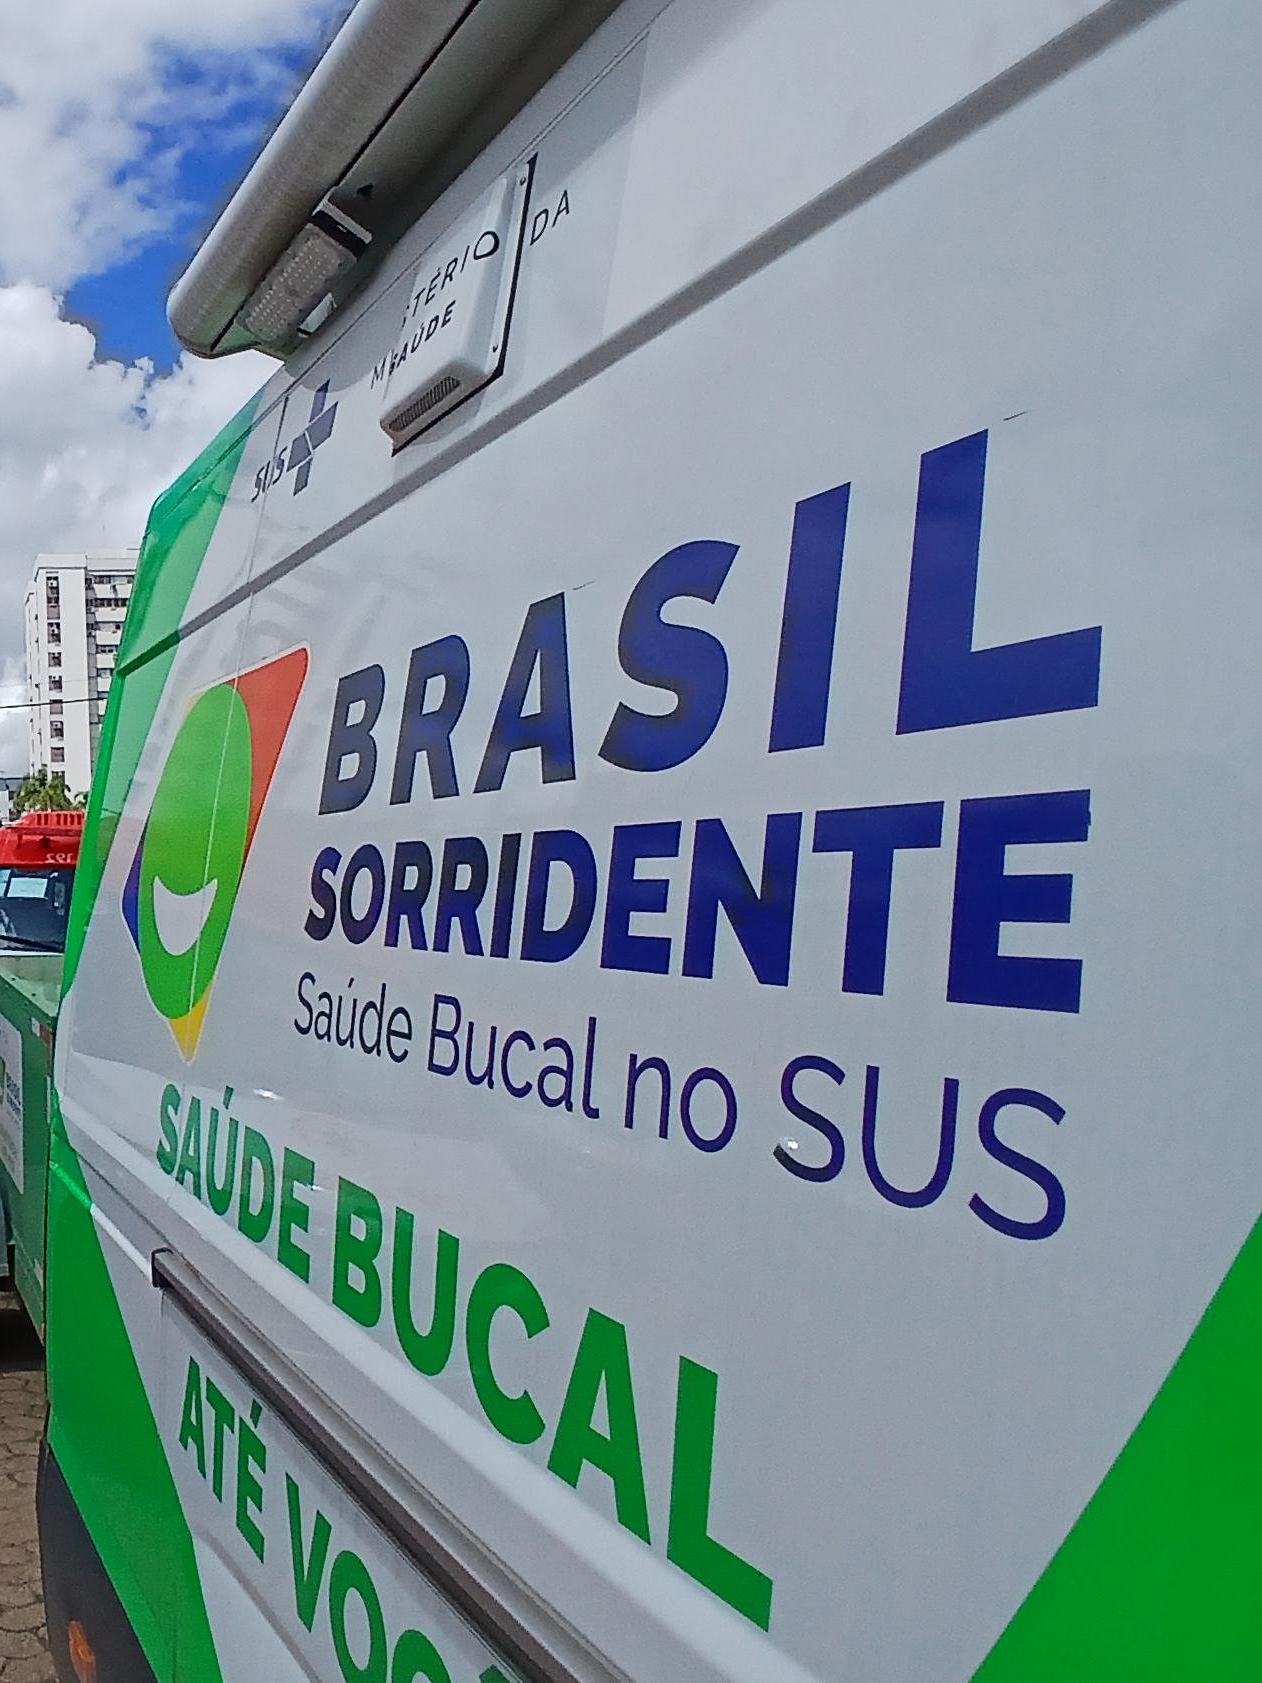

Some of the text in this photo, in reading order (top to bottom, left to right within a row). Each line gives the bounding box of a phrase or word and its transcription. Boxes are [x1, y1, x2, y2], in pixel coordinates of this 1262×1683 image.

[529, 189, 571, 246] DA
[250, 446, 288, 503] SUS
[318, 428, 1102, 816] BRASIL
[304, 789, 1091, 1013] SORRIDENTE
[294, 971, 1067, 1240] Saúde Bucal no SUS
[155, 1084, 773, 1632] SAÚDE BUCAL
[180, 1356, 515, 1683] ATÉ VO
